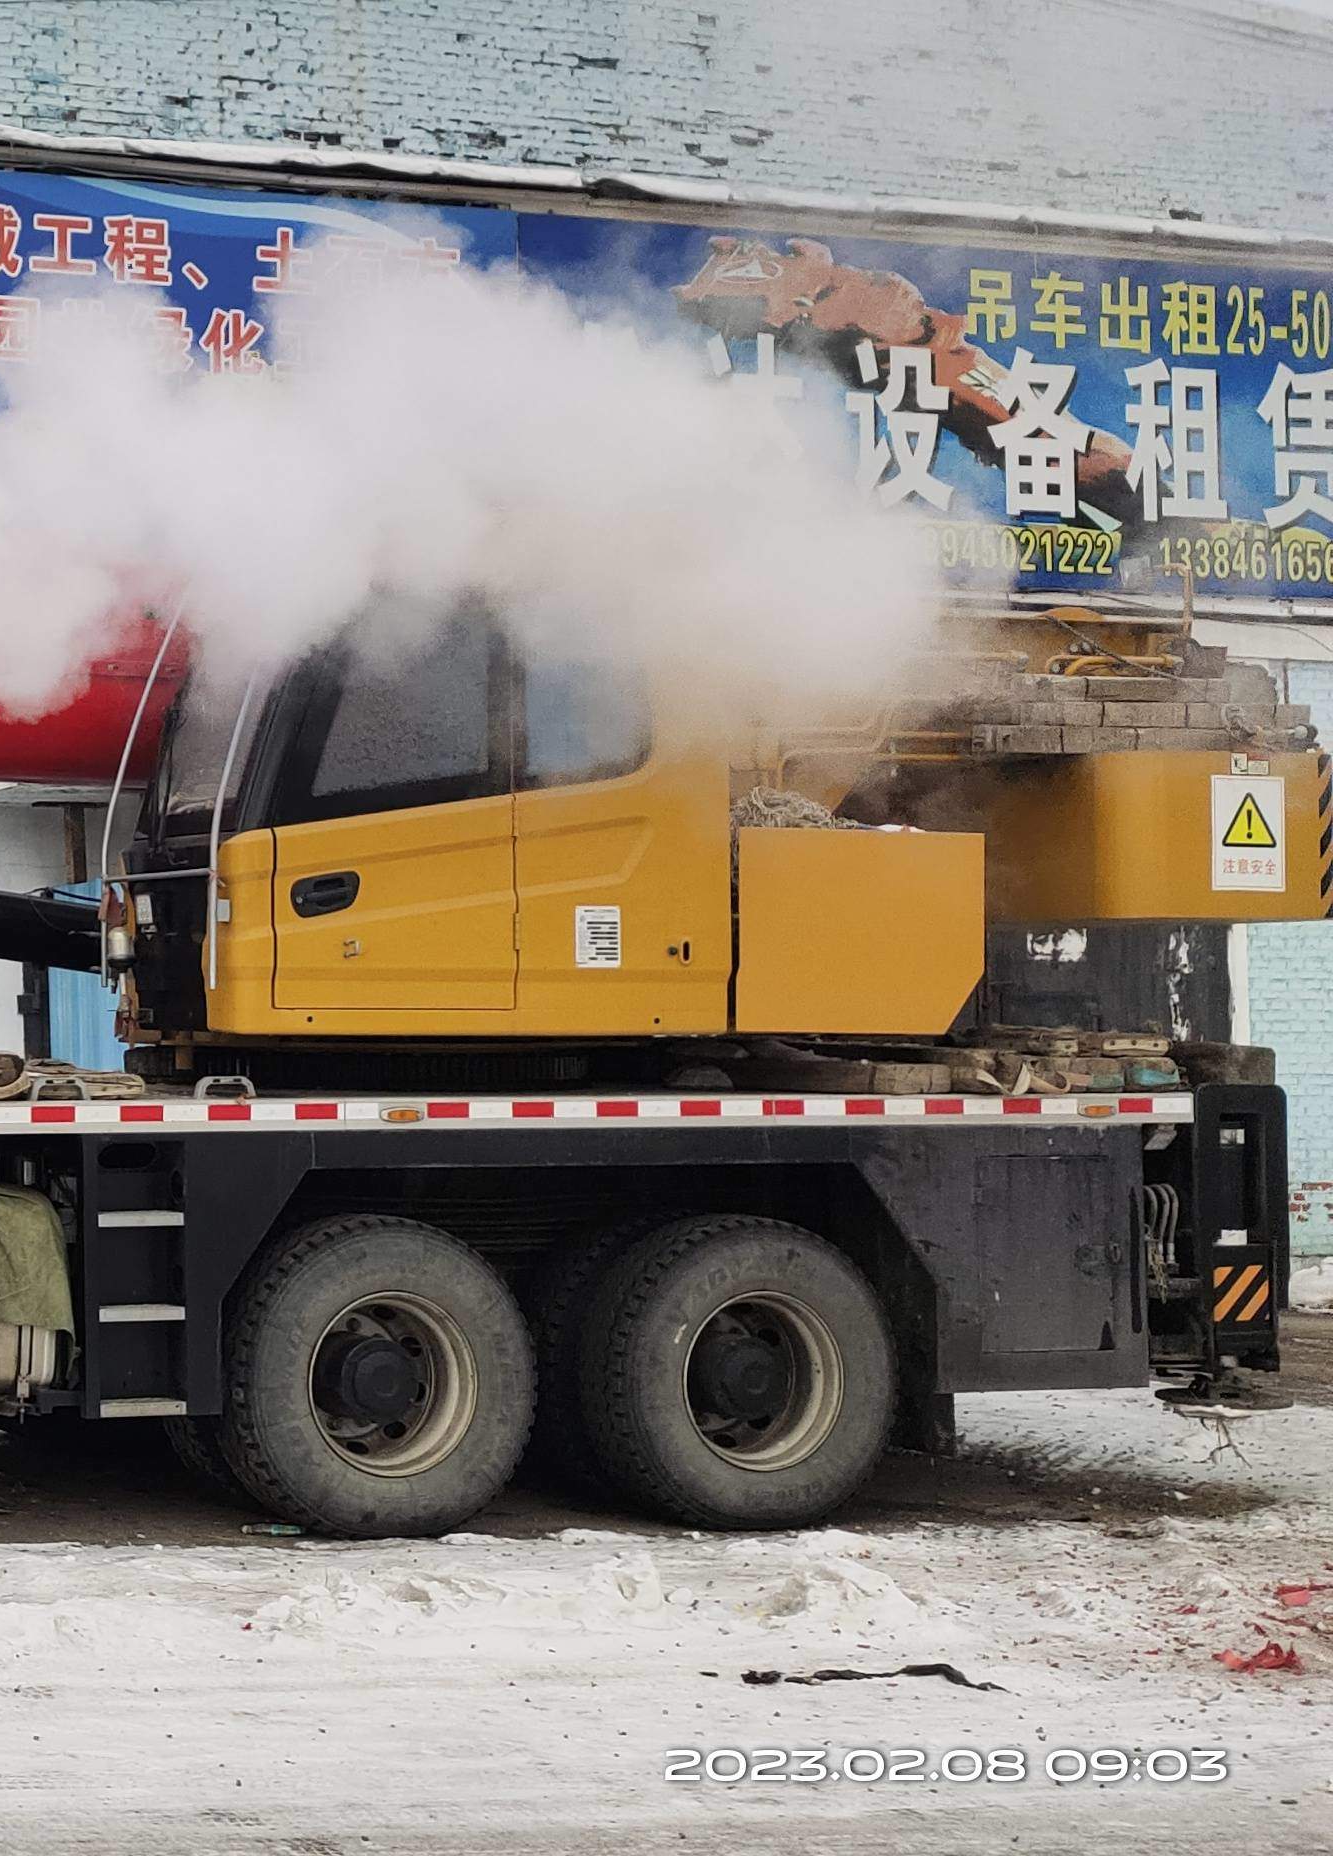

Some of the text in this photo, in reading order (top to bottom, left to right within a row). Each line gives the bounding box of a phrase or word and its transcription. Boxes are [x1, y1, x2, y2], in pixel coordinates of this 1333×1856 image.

[965, 268, 1331, 359] 吊车出租25-50
[1223, 858, 1276, 875] 注意安全
